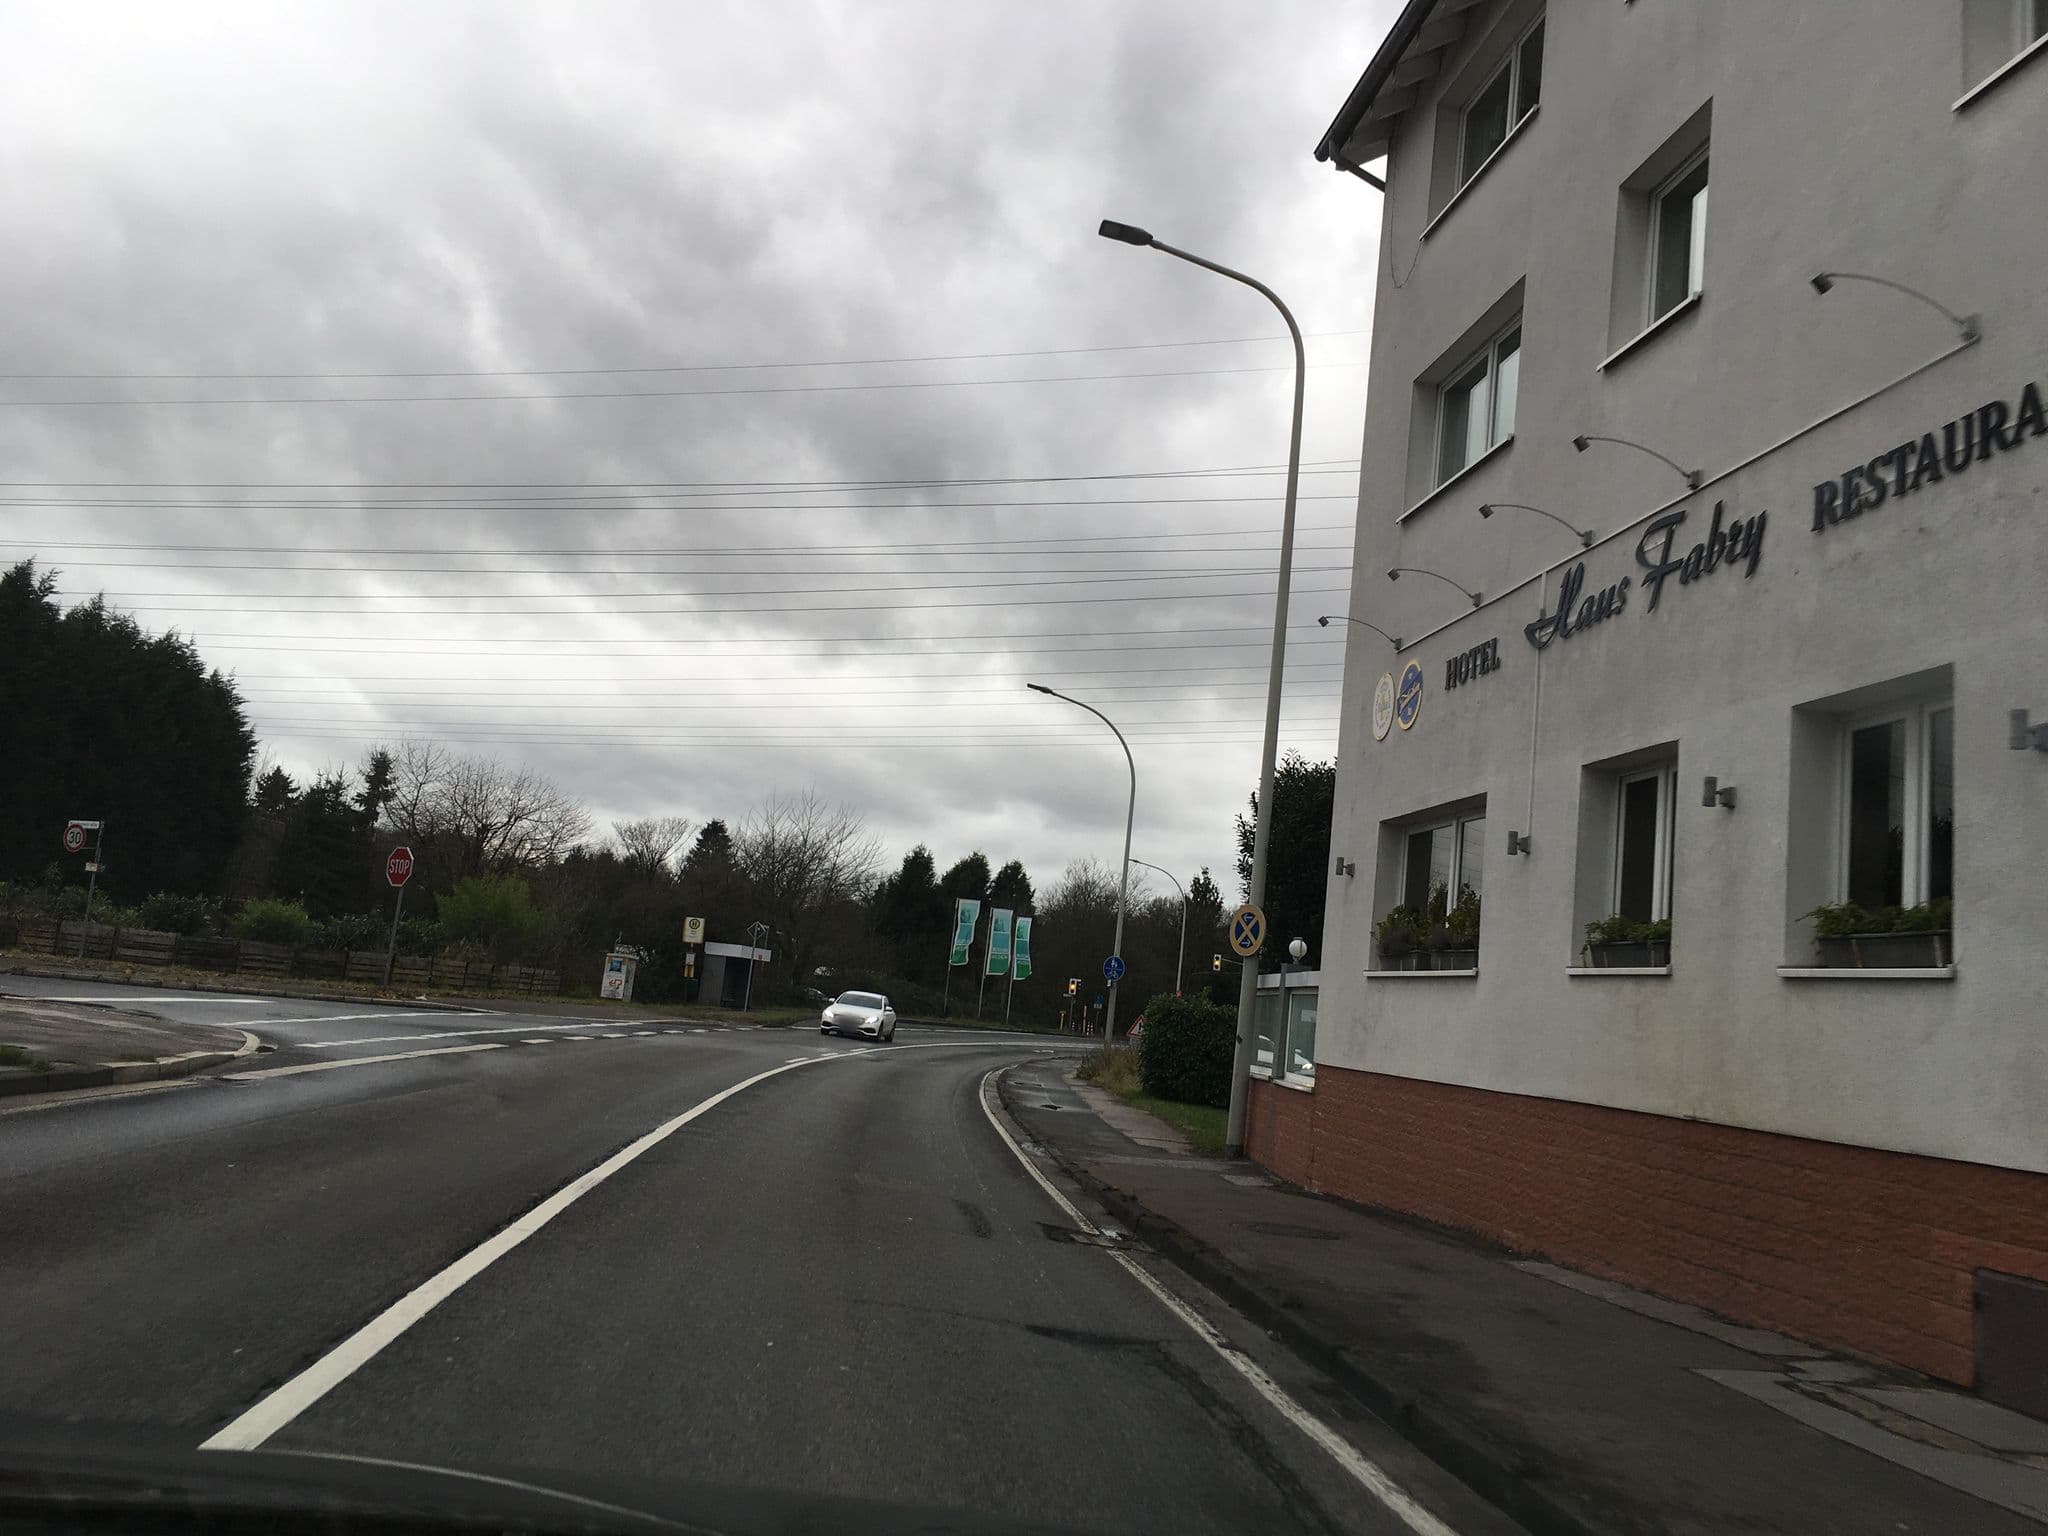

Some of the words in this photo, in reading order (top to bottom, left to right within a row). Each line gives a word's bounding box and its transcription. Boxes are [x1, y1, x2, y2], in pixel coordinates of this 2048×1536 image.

[1445, 637, 1502, 691] HOTEL
[1524, 562, 1631, 649] Haus
[1635, 499, 1768, 613] Fabry
[68, 831, 81, 844] 30
[389, 859, 410, 875] STOP
